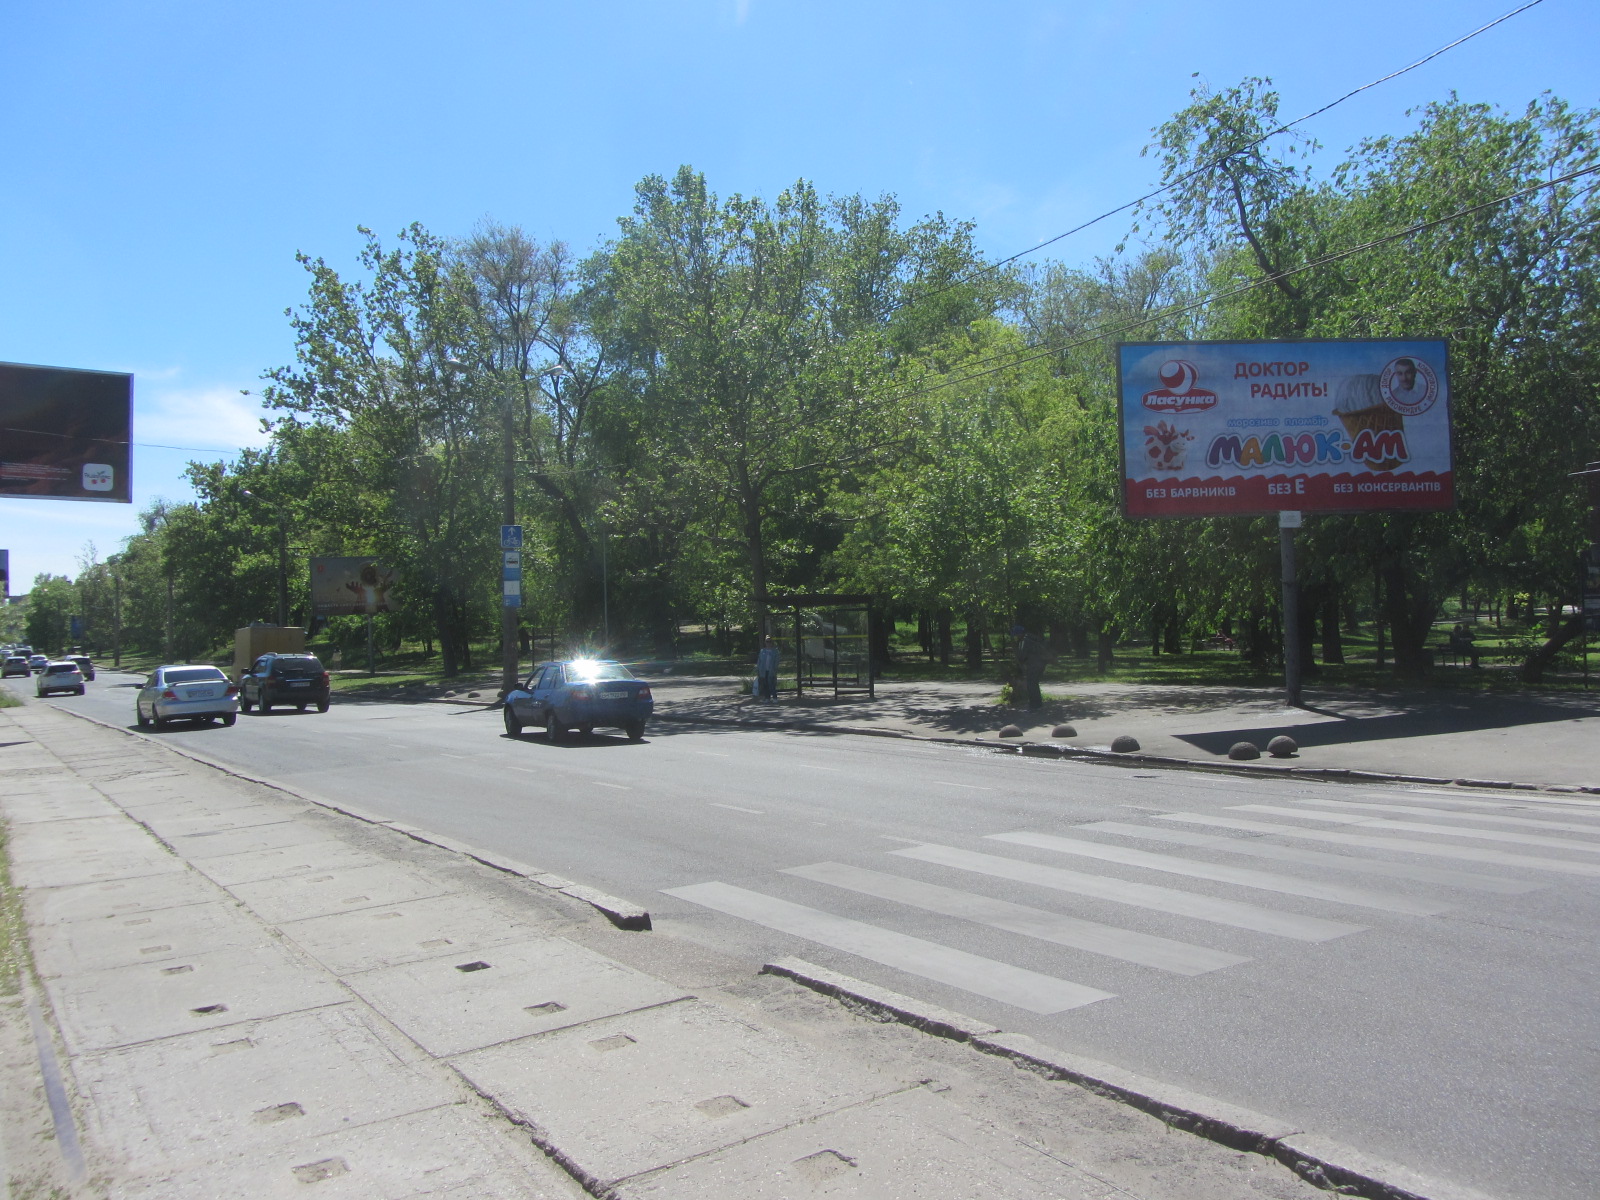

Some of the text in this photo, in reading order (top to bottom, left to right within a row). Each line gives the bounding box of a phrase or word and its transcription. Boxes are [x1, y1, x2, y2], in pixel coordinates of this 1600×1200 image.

[1234, 361, 1310, 380] ДОКТОР
[1250, 382, 1328, 400] РАДИТЬ!
[1145, 394, 1216, 408] Ласунка
[1226, 415, 1329, 429] морозиво пломбір
[1146, 486, 1236, 499] БЕЗ БАРВНИКІВ
[1268, 478, 1306, 495] БЕЗ Е
[1333, 482, 1441, 493] БЕЗ КОНСЕРВАНТІВ
